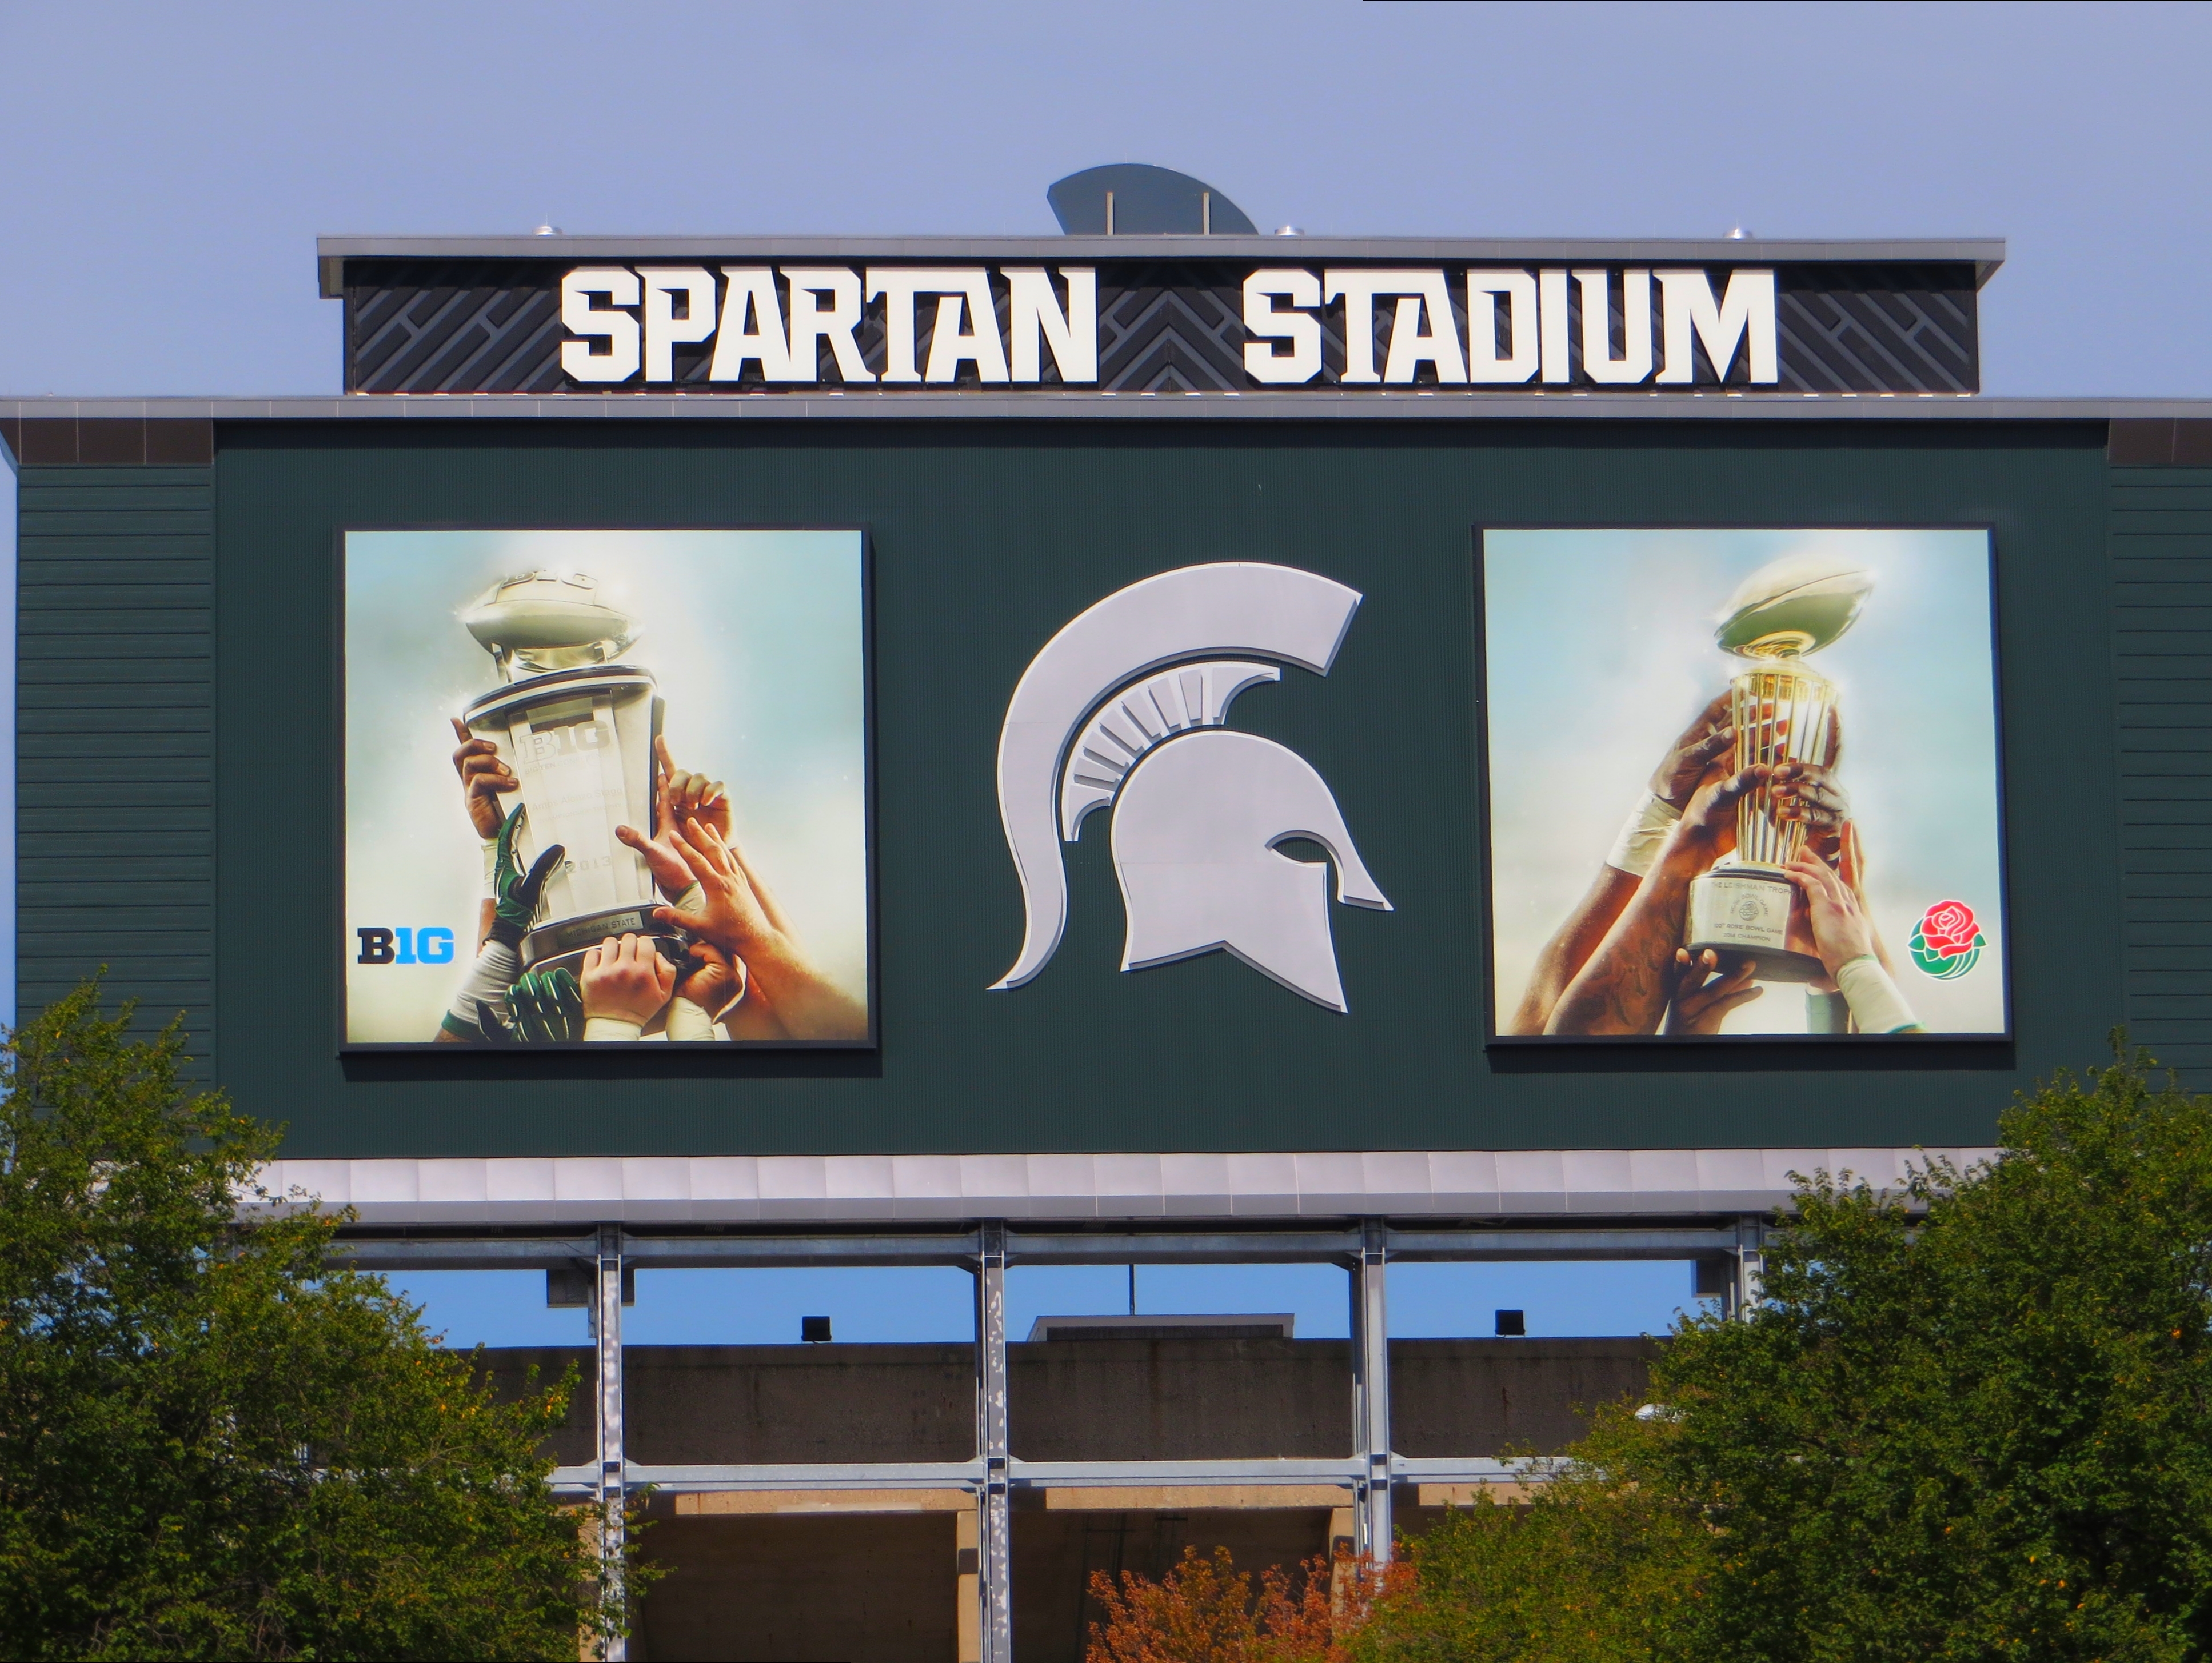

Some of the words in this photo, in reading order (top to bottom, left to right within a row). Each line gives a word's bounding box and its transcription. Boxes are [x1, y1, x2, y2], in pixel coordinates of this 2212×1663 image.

[561, 266, 1098, 382] SPARTAN
[1243, 268, 1779, 383] STADIUM
[566, 922, 609, 938] MICHIGAN
[611, 917, 636, 929] STATE
